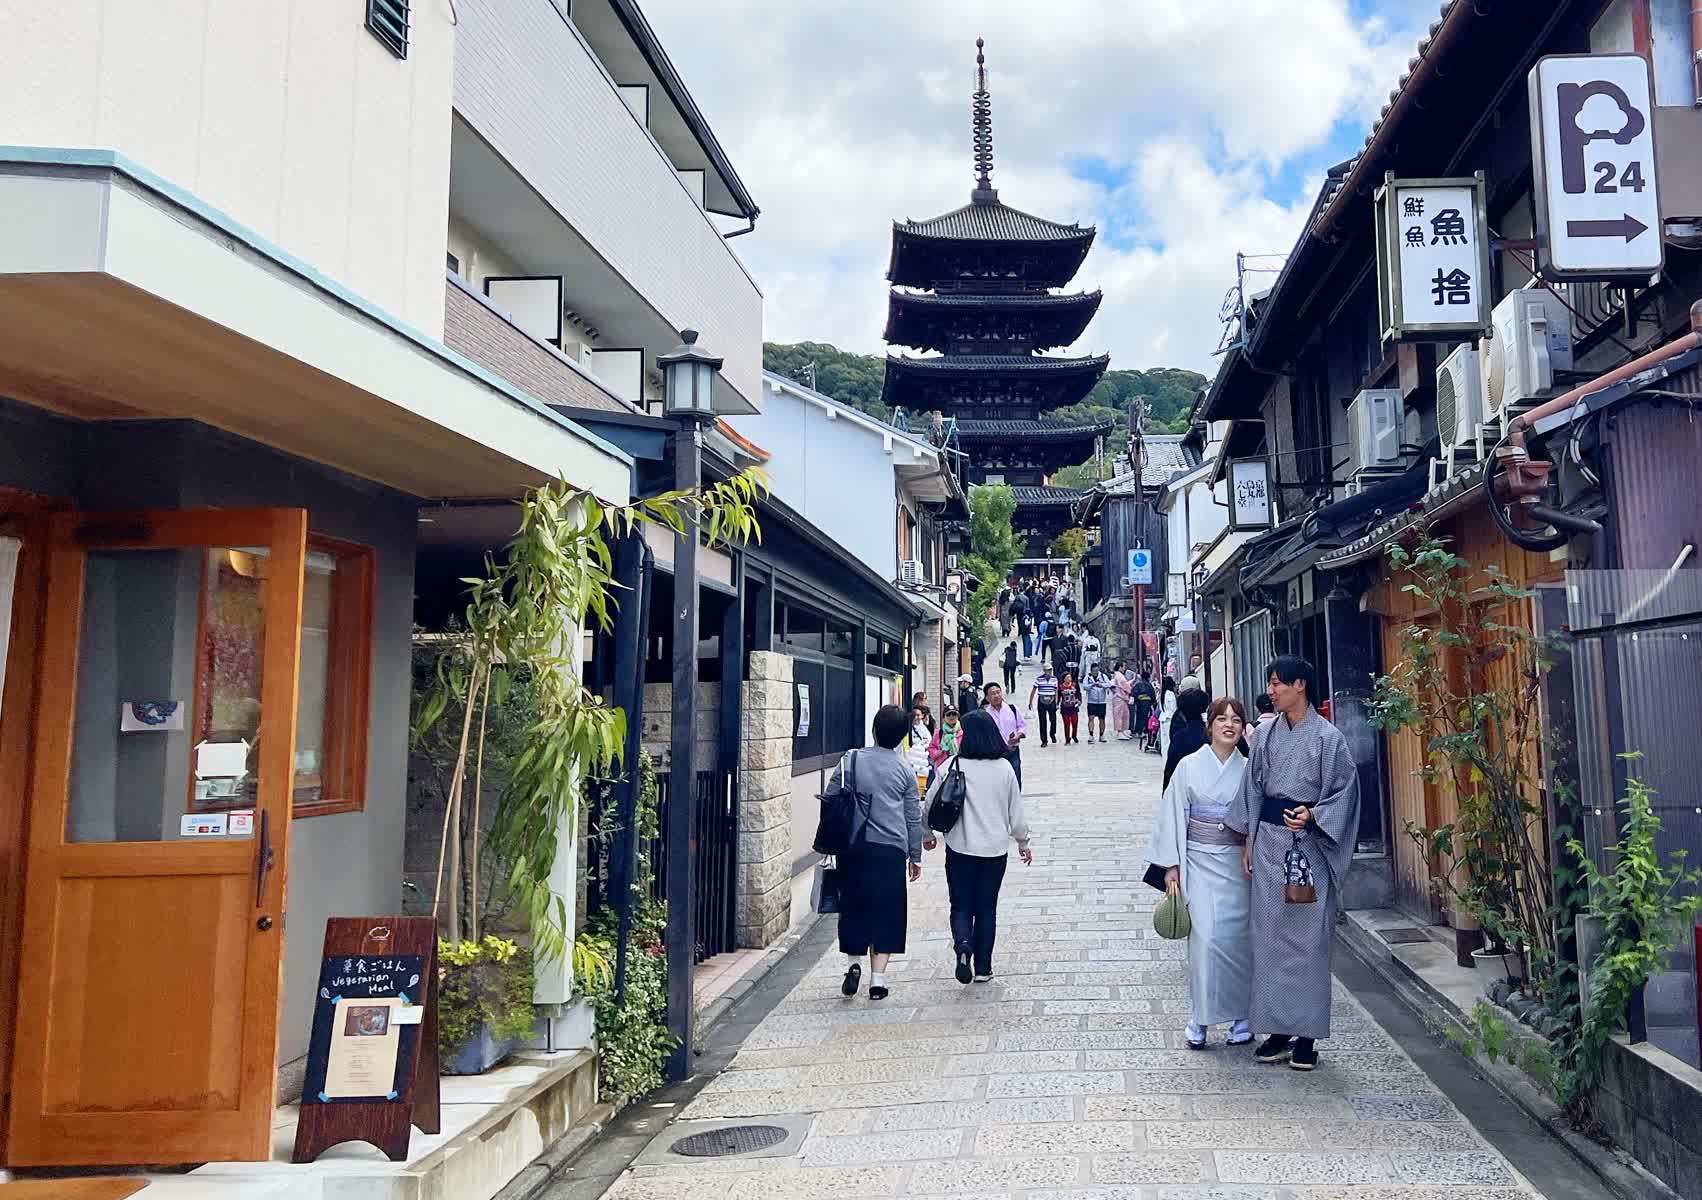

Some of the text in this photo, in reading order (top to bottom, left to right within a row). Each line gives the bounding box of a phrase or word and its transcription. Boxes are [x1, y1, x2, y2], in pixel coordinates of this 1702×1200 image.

[1593, 161, 1646, 194] 24
[1403, 196, 1426, 248] 鮮魚
[1430, 208, 1471, 307] 魚捨
[368, 980, 394, 995] Meal
